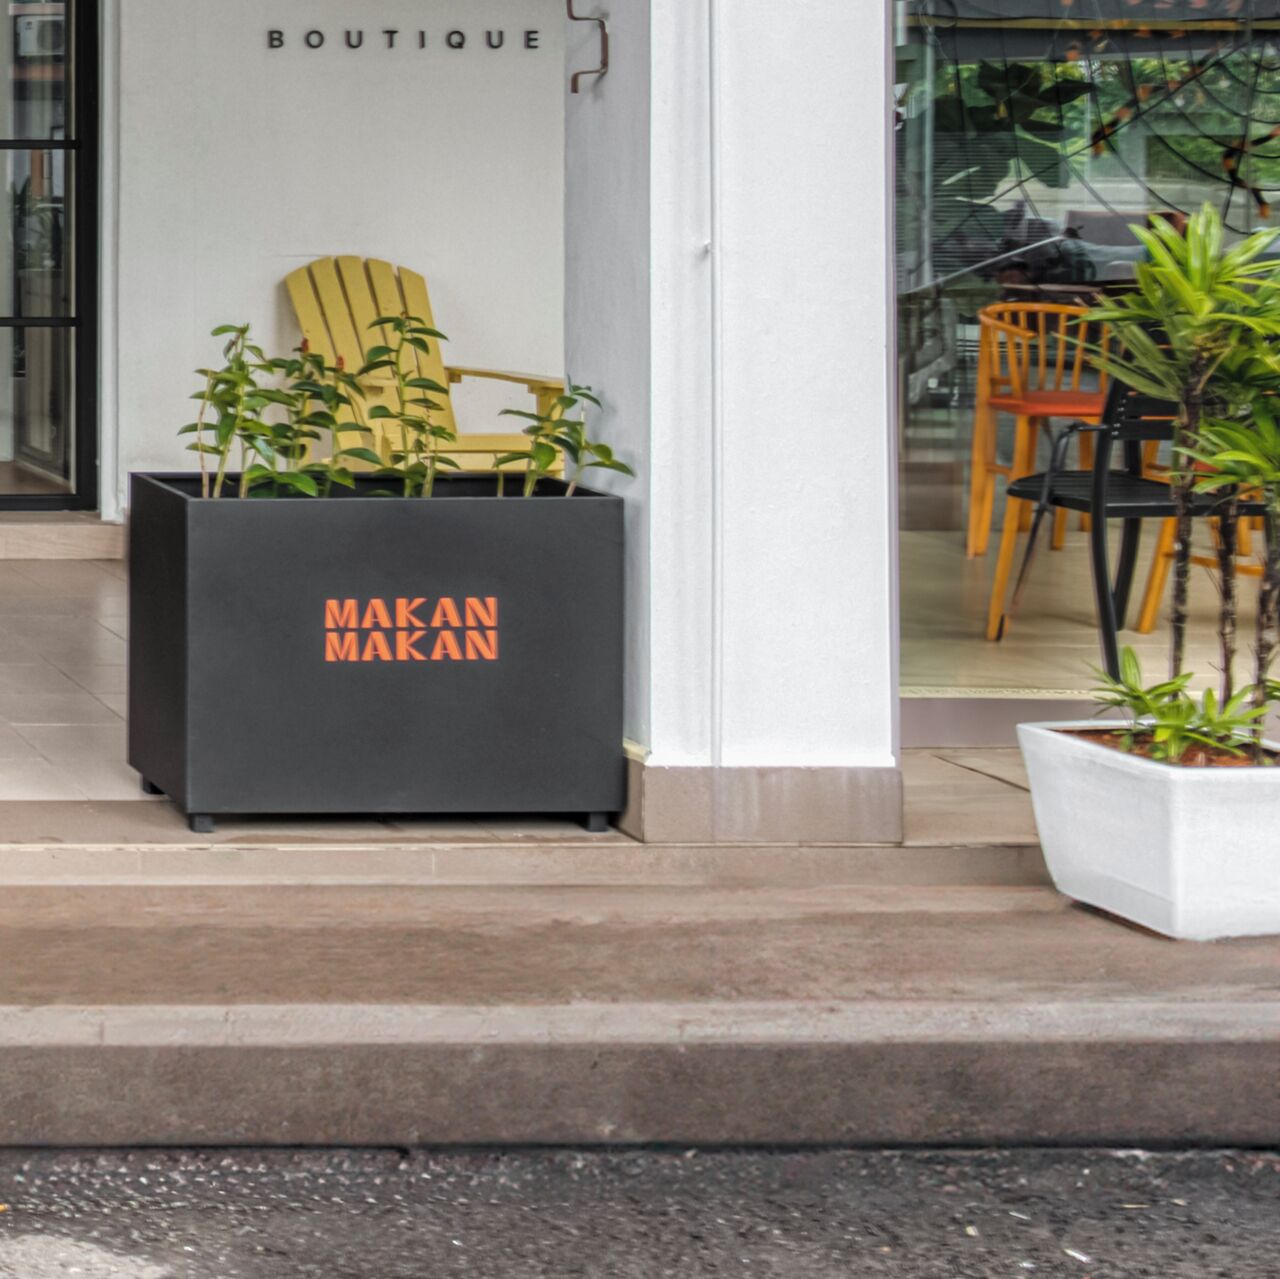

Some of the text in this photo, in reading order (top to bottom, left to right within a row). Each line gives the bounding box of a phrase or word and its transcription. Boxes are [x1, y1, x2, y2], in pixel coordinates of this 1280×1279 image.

[266, 29, 540, 50] BOUTIQUE
[324, 597, 498, 629] MAKAN
[324, 630, 498, 662] MAKAN
